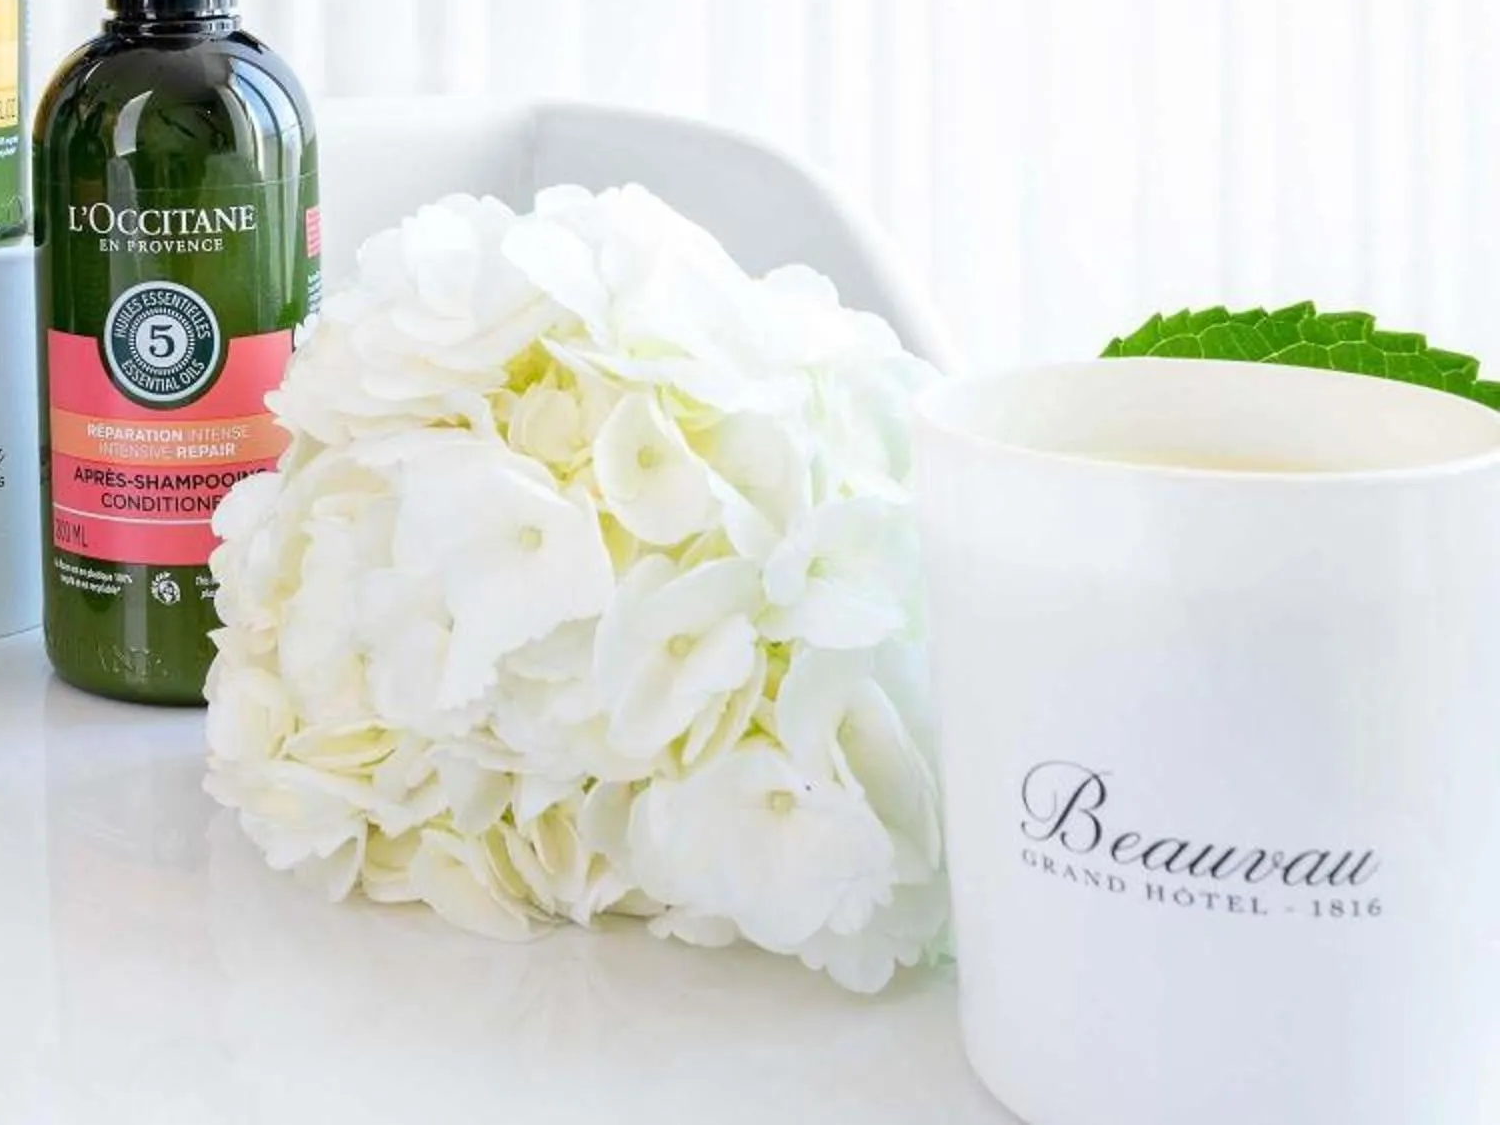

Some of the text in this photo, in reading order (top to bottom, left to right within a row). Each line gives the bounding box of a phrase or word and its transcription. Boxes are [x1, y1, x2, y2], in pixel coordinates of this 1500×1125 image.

[68, 203, 258, 235] L'OCCITANE
[100, 238, 224, 254] EN PROVENCE
[114, 291, 211, 339] HUILES ESSENTIELLES
[149, 324, 175, 358] 5
[121, 359, 206, 392] ESSENTIAL OILS
[87, 422, 250, 442] RÉPARATION INTENSE
[99, 442, 236, 460] INTENSIVE REPAIR
[74, 466, 267, 491] APRÈS-SHAMPOOI
[101, 492, 222, 512] CONDITIONE
[1020, 759, 1382, 887] Beauvau
[1021, 848, 1127, 894] GRAND
[1146, 881, 1268, 916] HÔTEL
[1311, 898, 1383, 918] 1816
